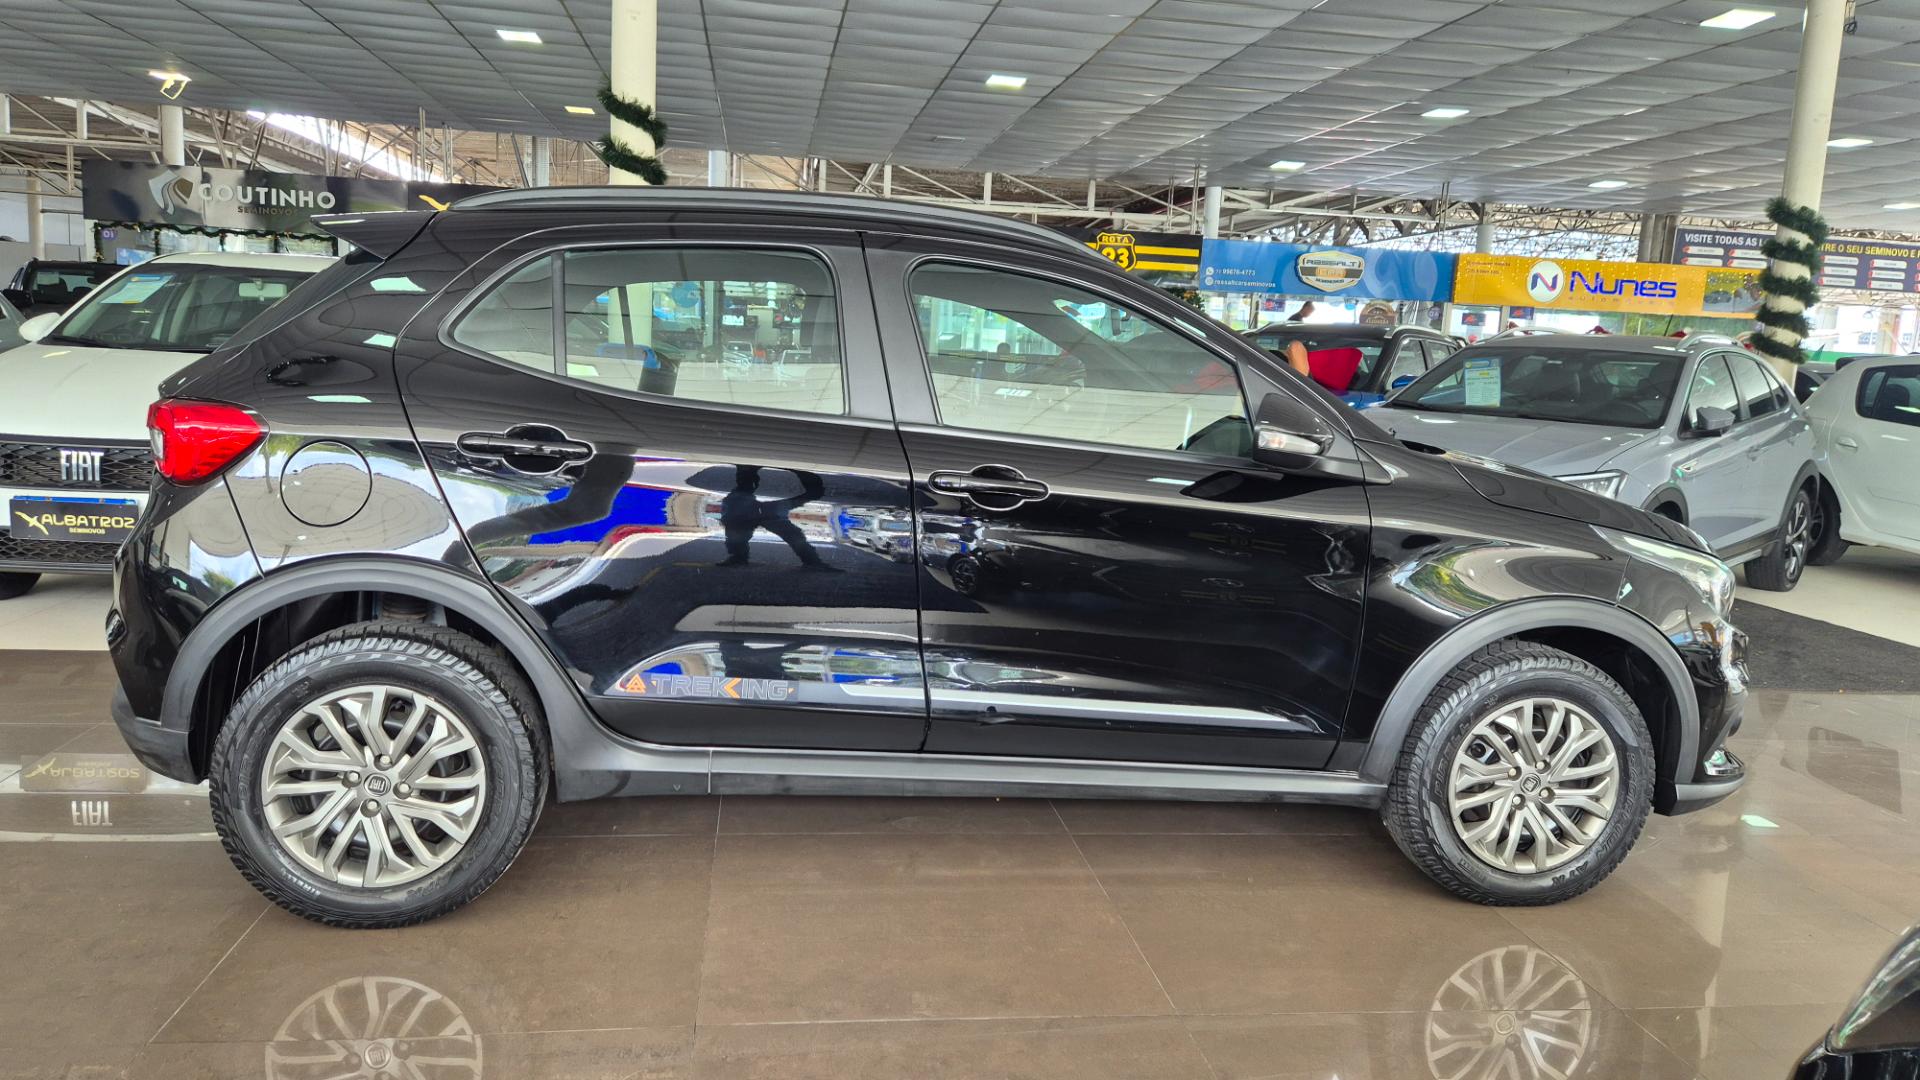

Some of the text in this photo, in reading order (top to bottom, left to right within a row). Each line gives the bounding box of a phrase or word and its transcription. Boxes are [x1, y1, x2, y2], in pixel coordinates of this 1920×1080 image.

[199, 183, 336, 209] COUTINHO
[1102, 235, 1129, 244] ROTA
[1684, 233, 1713, 244] VISITE
[1714, 235, 1745, 246] TODAS
[1745, 237, 1758, 247] AS
[1838, 244, 1845, 253] O
[1846, 245, 1864, 254] SEU
[1865, 246, 1909, 258] SEMINOVO
[1569, 270, 1678, 299] Nunes
[60, 449, 105, 482] FIAT
[41, 513, 136, 529] ALBATROZ
